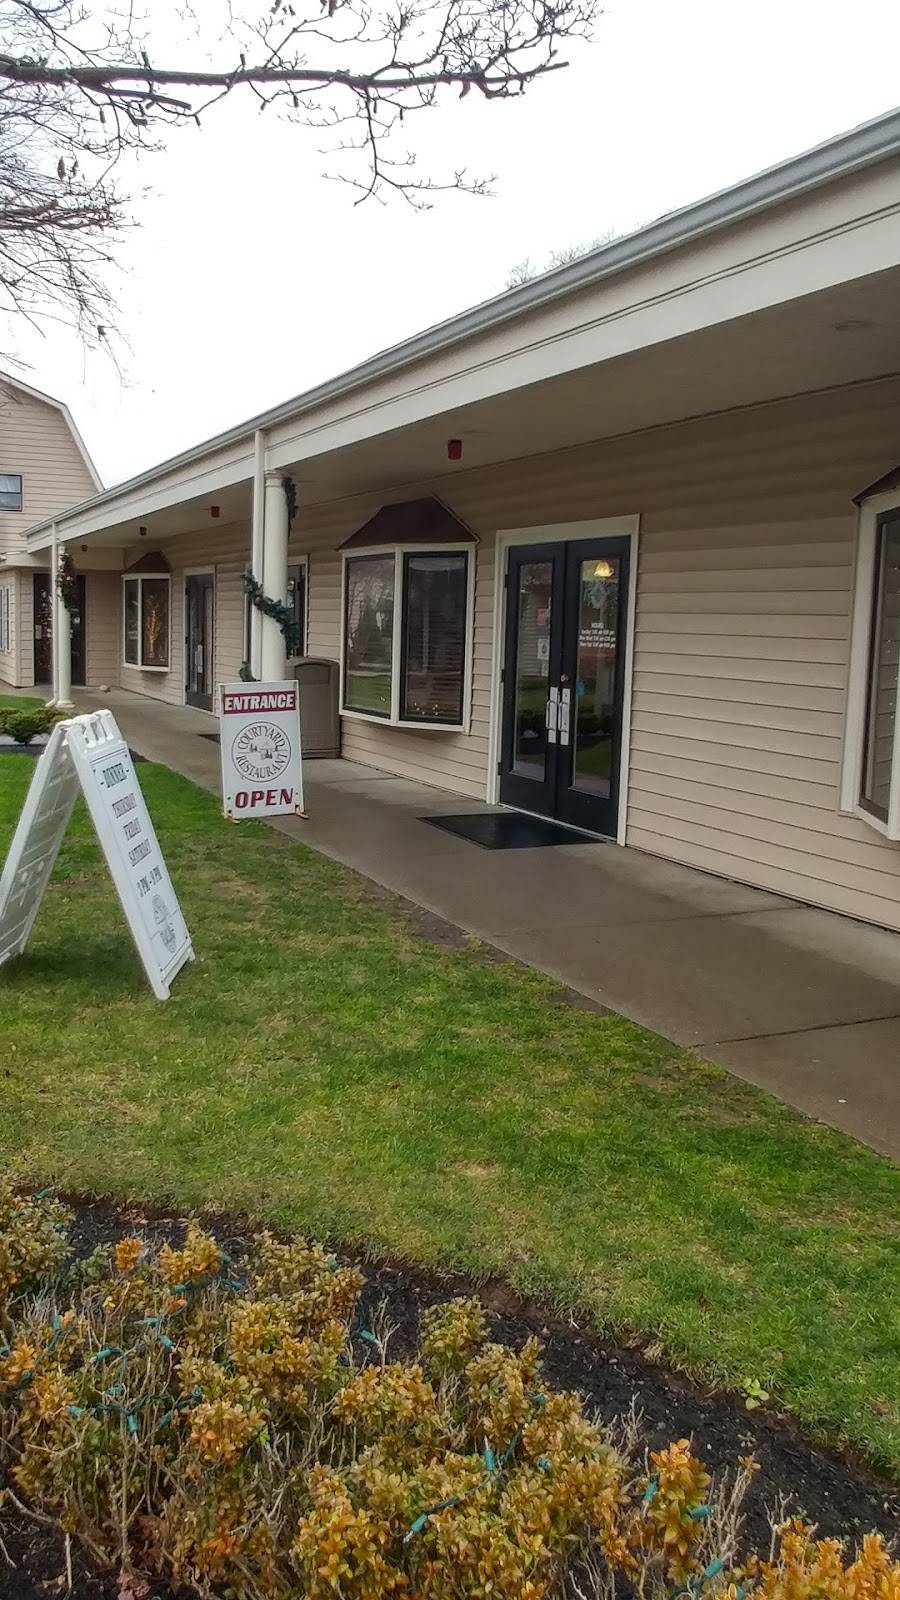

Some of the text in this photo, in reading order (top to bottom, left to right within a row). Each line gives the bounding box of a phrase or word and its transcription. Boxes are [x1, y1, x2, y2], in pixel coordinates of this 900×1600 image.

[224, 693, 295, 711] ENTRANCE
[237, 725, 286, 750] COURTYARD
[235, 753, 288, 778] RESTAURANT
[111, 792, 137, 819] THURSDAY
[234, 787, 294, 809] OPEN
[122, 817, 141, 841] FRIDAY
